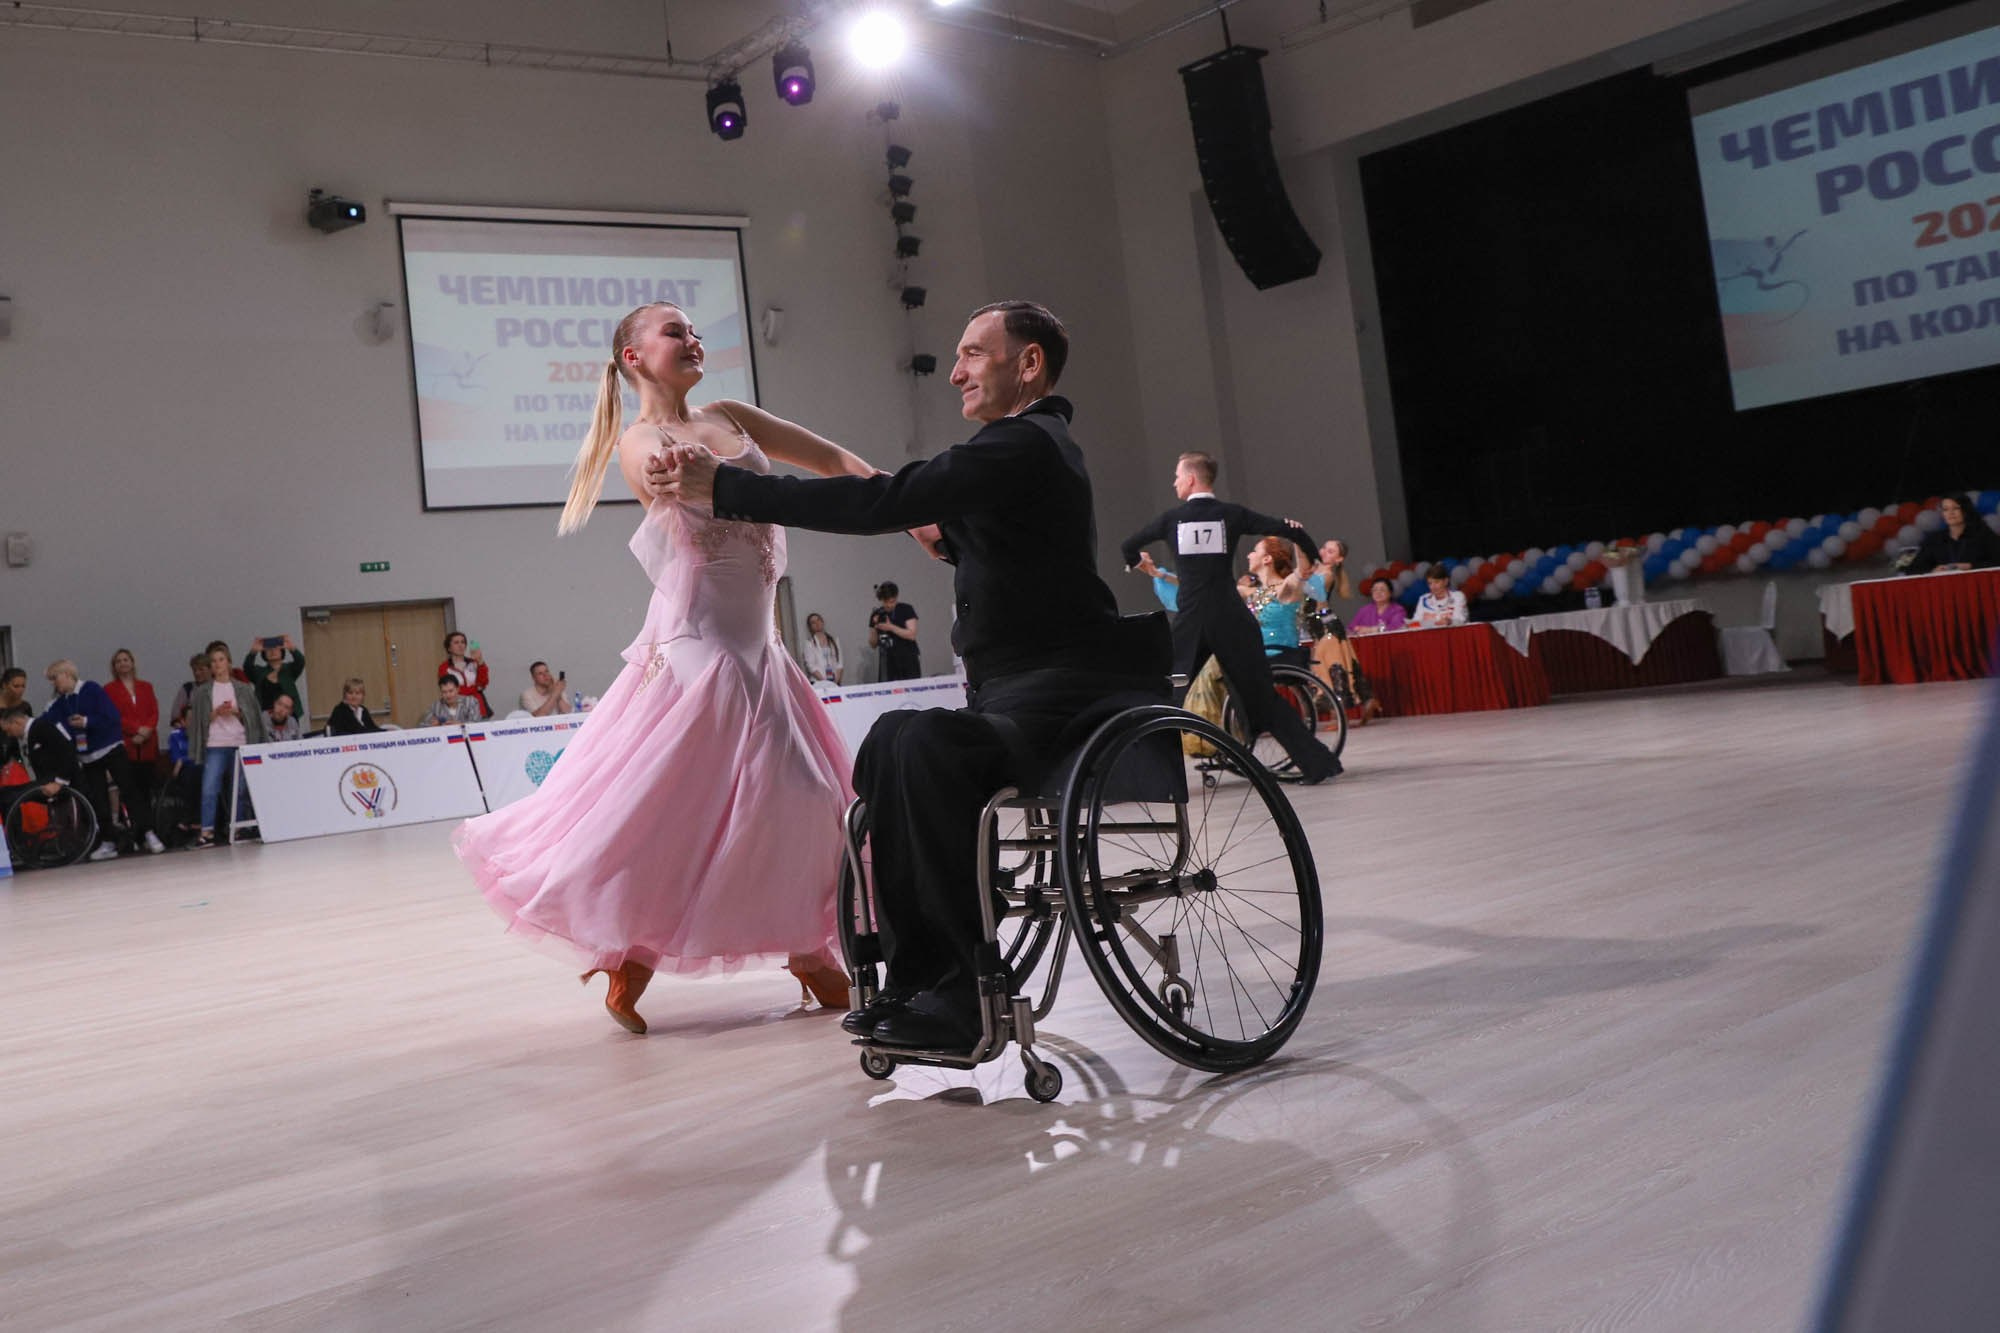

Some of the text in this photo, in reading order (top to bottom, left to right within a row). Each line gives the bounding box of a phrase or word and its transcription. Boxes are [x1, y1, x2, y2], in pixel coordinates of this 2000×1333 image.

[438, 274, 702, 307] ЧЕМПИОНАТ
[1853, 269, 1919, 306] ПО
[1836, 320, 1903, 356] НА
[514, 394, 549, 413] ПО
[503, 423, 539, 441] НА
[1194, 529, 1213, 545] 17
[268, 749, 312, 760] ЧЕМПИОНАТ
[313, 746, 340, 755] РОССИИ
[358, 743, 369, 751] ПО
[369, 740, 397, 749] ТАНЦАМ
[397, 738, 407, 747] НА
